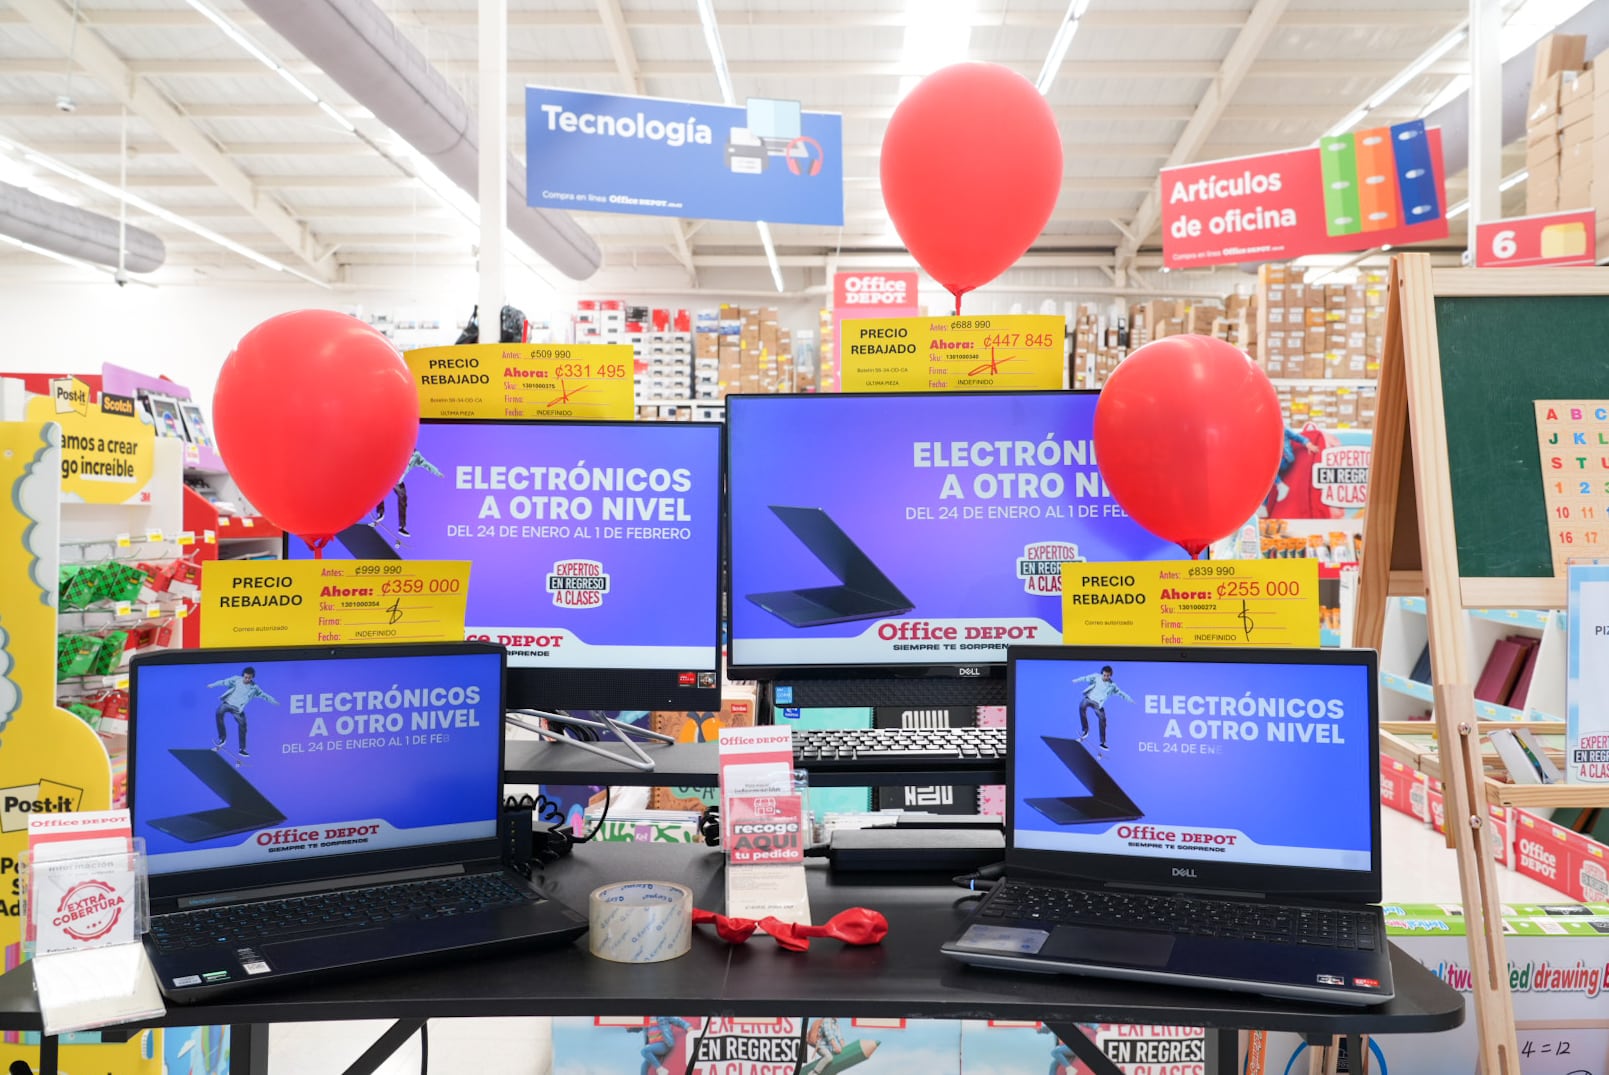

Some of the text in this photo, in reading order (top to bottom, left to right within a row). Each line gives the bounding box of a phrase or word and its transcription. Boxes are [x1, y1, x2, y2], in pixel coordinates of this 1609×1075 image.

[541, 104, 712, 147] Tecnología
[1169, 170, 1282, 204] Artículos
[1171, 206, 1297, 239] de oficina
[1492, 230, 1518, 259] 6
[845, 276, 907, 292] Office
[845, 292, 907, 304] DEPOT
[974, 320, 991, 329] 990
[860, 328, 908, 339] PRECIO
[930, 339, 974, 350] Ahora:
[1025, 333, 1053, 347] 845
[554, 350, 571, 359] 990
[851, 343, 916, 355] REBAJADO
[429, 358, 479, 369] PRECIO
[503, 367, 548, 378] Ahora:
[597, 364, 626, 378] 495
[421, 374, 490, 385] REBAJADO
[103, 397, 133, 412] Scotch
[536, 409, 573, 417] INDEFINIDO
[1546, 408, 1608, 421] A B C
[1549, 433, 1609, 445] J K L
[98, 439, 138, 455] a crear
[914, 433, 1097, 467] ELECTRÓNI
[1551, 457, 1587, 469] S T
[456, 460, 691, 492] ELECTRÓNICOS
[939, 474, 965, 499] A
[973, 473, 1064, 499] OTRO
[1326, 485, 1334, 501] A
[1555, 482, 1563, 494] 1
[1580, 482, 1591, 494] 2
[478, 495, 691, 521] A OTRO NIVEL
[905, 507, 934, 520] DEL
[938, 507, 958, 520] 24
[963, 506, 983, 519] DE
[988, 505, 1041, 519] ENERO
[1045, 505, 1064, 518] AL
[1067, 505, 1073, 518] 1
[1078, 505, 1098, 518] DE
[1556, 507, 1569, 519] 10
[1581, 507, 1595, 519] 11
[447, 525, 691, 540] DEL 24 DE ENERO AL 1 DE FEBRERO
[1559, 531, 1598, 544] 16 17
[1028, 545, 1075, 560] EXPERTOS
[321, 568, 344, 577] Antes:
[382, 565, 402, 575] 990
[556, 562, 600, 576] EXPERTOS
[1023, 562, 1036, 575] EN
[1159, 571, 1181, 580] Antes:
[1216, 567, 1235, 576] 990
[232, 576, 293, 588] PRECIO
[320, 586, 374, 598] Ahora:
[429, 578, 460, 594] 000
[551, 577, 604, 590] EN REGRESO
[1028, 576, 1035, 590] A
[1082, 575, 1135, 587] PRECIO
[1160, 588, 1212, 600] Ahora:
[1266, 581, 1300, 596] 000
[220, 594, 303, 608] REBAJADO
[556, 591, 600, 605] A CLASES
[1072, 593, 1146, 605] REBAJADO
[319, 602, 335, 612] Sku:
[1160, 605, 1176, 614] Sku:
[318, 617, 342, 626] Firma:
[1160, 620, 1183, 629] Firma:
[318, 629, 397, 642] Fecha: INDEFINIDO
[878, 622, 1038, 640] Office DEPOT
[497, 635, 564, 648] DEPOT
[1161, 634, 1237, 644] Fecha: INDEFINIDO
[893, 643, 957, 651] SIEMPRE TE
[959, 668, 980, 676] DELL
[290, 684, 481, 715] ELECTRÓNICOS
[1144, 691, 1345, 719] ELECTRÓNICOS
[309, 708, 480, 737] A OTRO NIVEL
[1163, 719, 1345, 744] A OTRO NIVEL
[282, 734, 427, 754] DEL 24 DE ENERO AL DE
[720, 735, 790, 746] Office DEPOT
[1138, 742, 1197, 754] DEL 24 DE
[1576, 751, 1587, 762] EN
[1580, 764, 1587, 777] A
[31, 816, 128, 828] Office DEPOT
[734, 823, 798, 835] recoge
[256, 824, 380, 846] Office DEPOT
[1117, 826, 1237, 846] Office DEPOT
[268, 837, 369, 853] SIEMPRE SORPRENDE
[1177, 845, 1226, 853] SORPRENDE
[735, 849, 799, 861] tu pedido
[1520, 839, 1557, 867] Office
[1172, 867, 1197, 878] DELL
[1520, 854, 1557, 880] DEPOT
[67, 893, 107, 913] EXTRA
[53, 896, 125, 927] COBERTURA
[1534, 961, 1600, 996] drawing
[699, 1039, 720, 1060] EN
[1108, 1041, 1131, 1063] EN
[1555, 1041, 1571, 1056] 12
